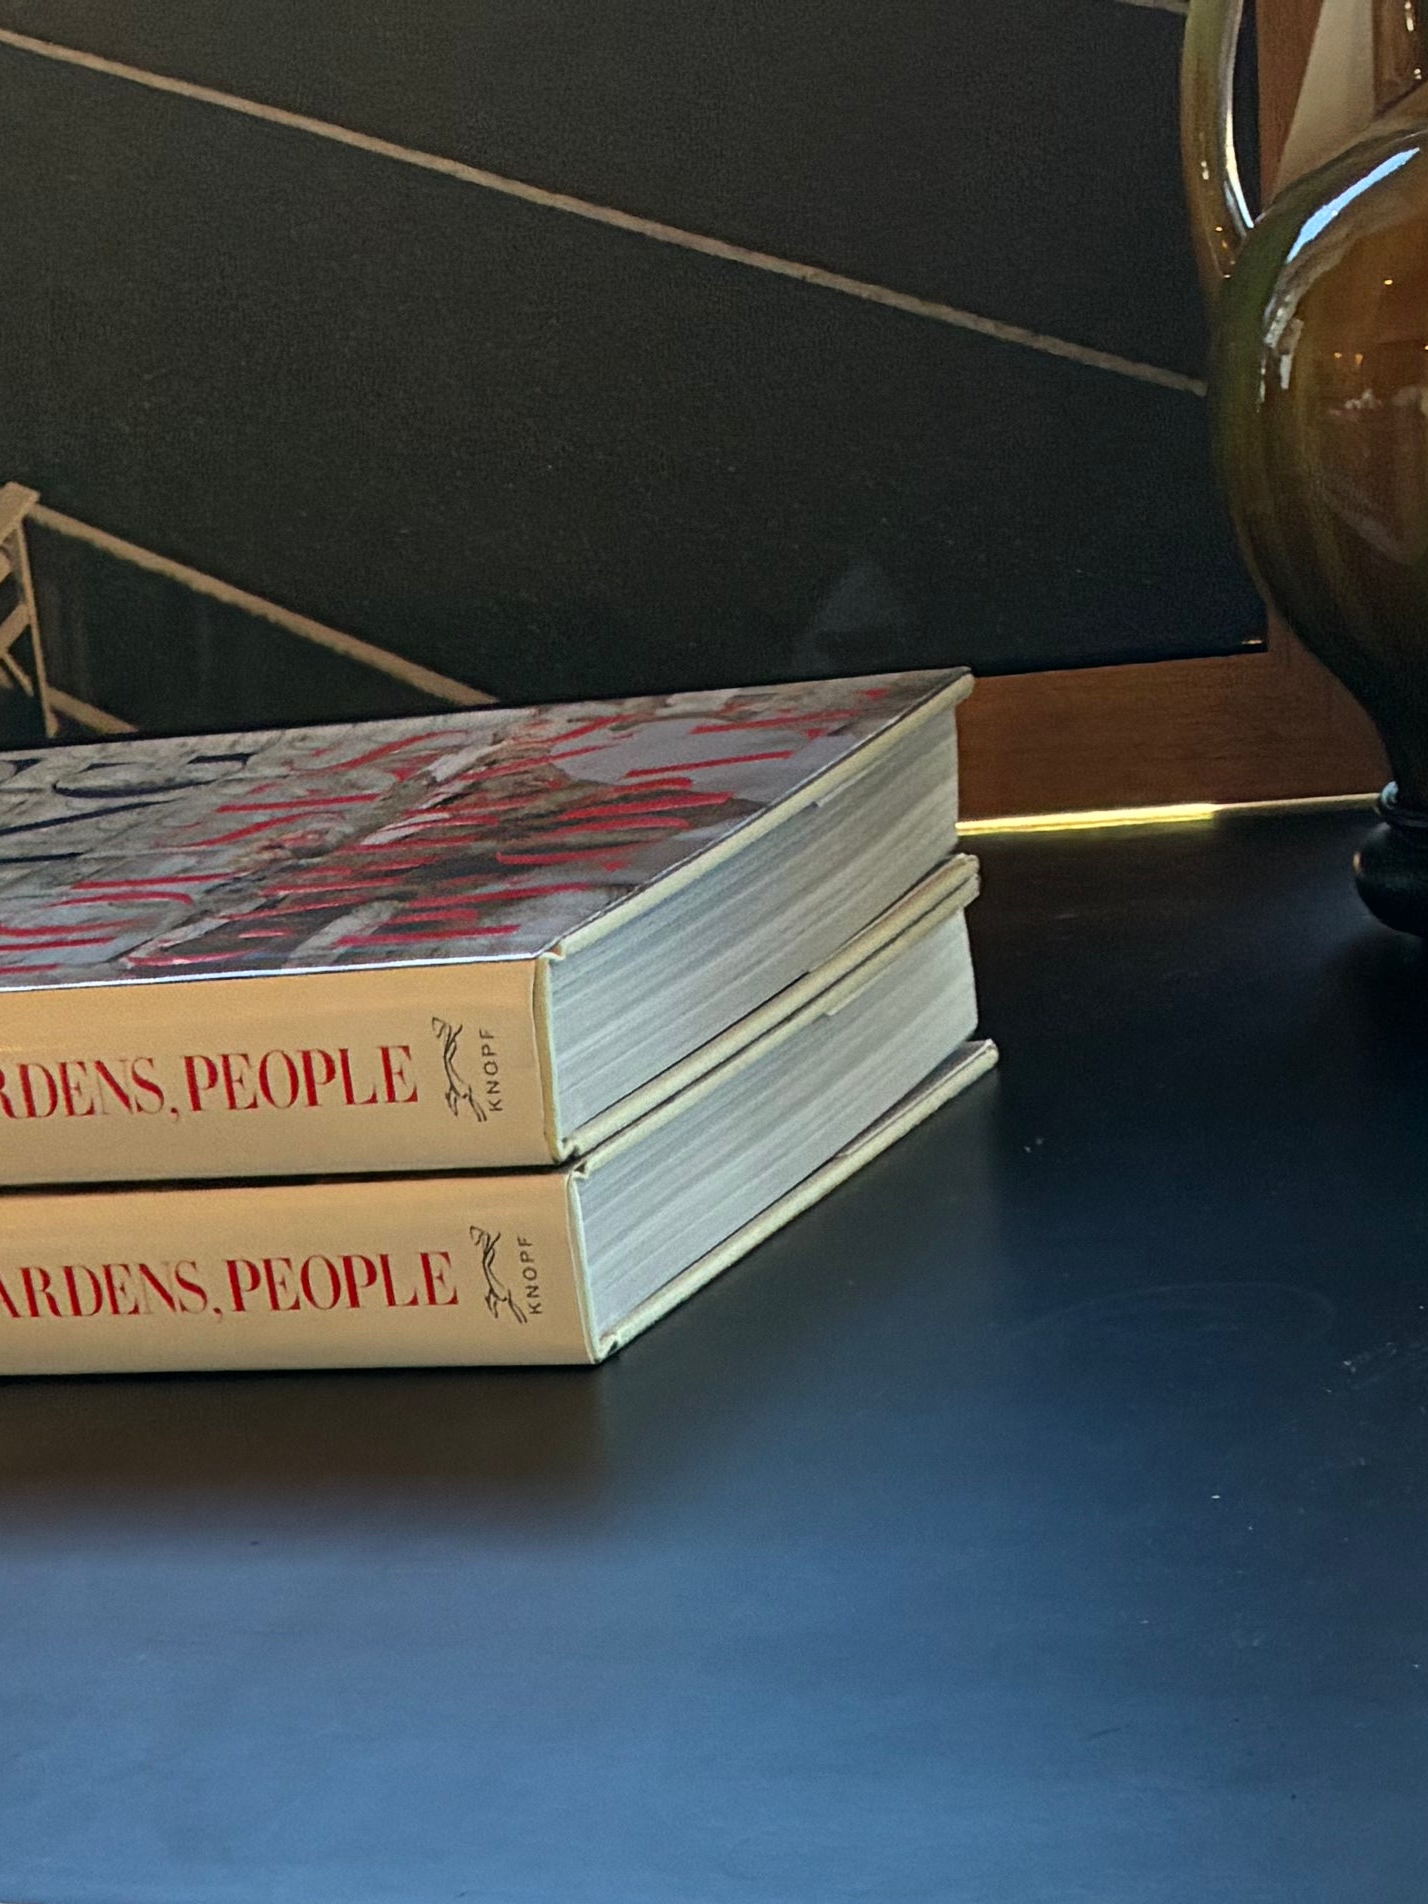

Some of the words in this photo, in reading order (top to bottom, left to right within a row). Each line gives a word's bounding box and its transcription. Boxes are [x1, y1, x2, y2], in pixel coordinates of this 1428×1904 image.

[183, 1044, 419, 1113] PEOPLE
[478, 1027, 503, 1113] KNOPF
[225, 1249, 459, 1314] PEOPLE
[516, 1234, 543, 1316] KNOPF
